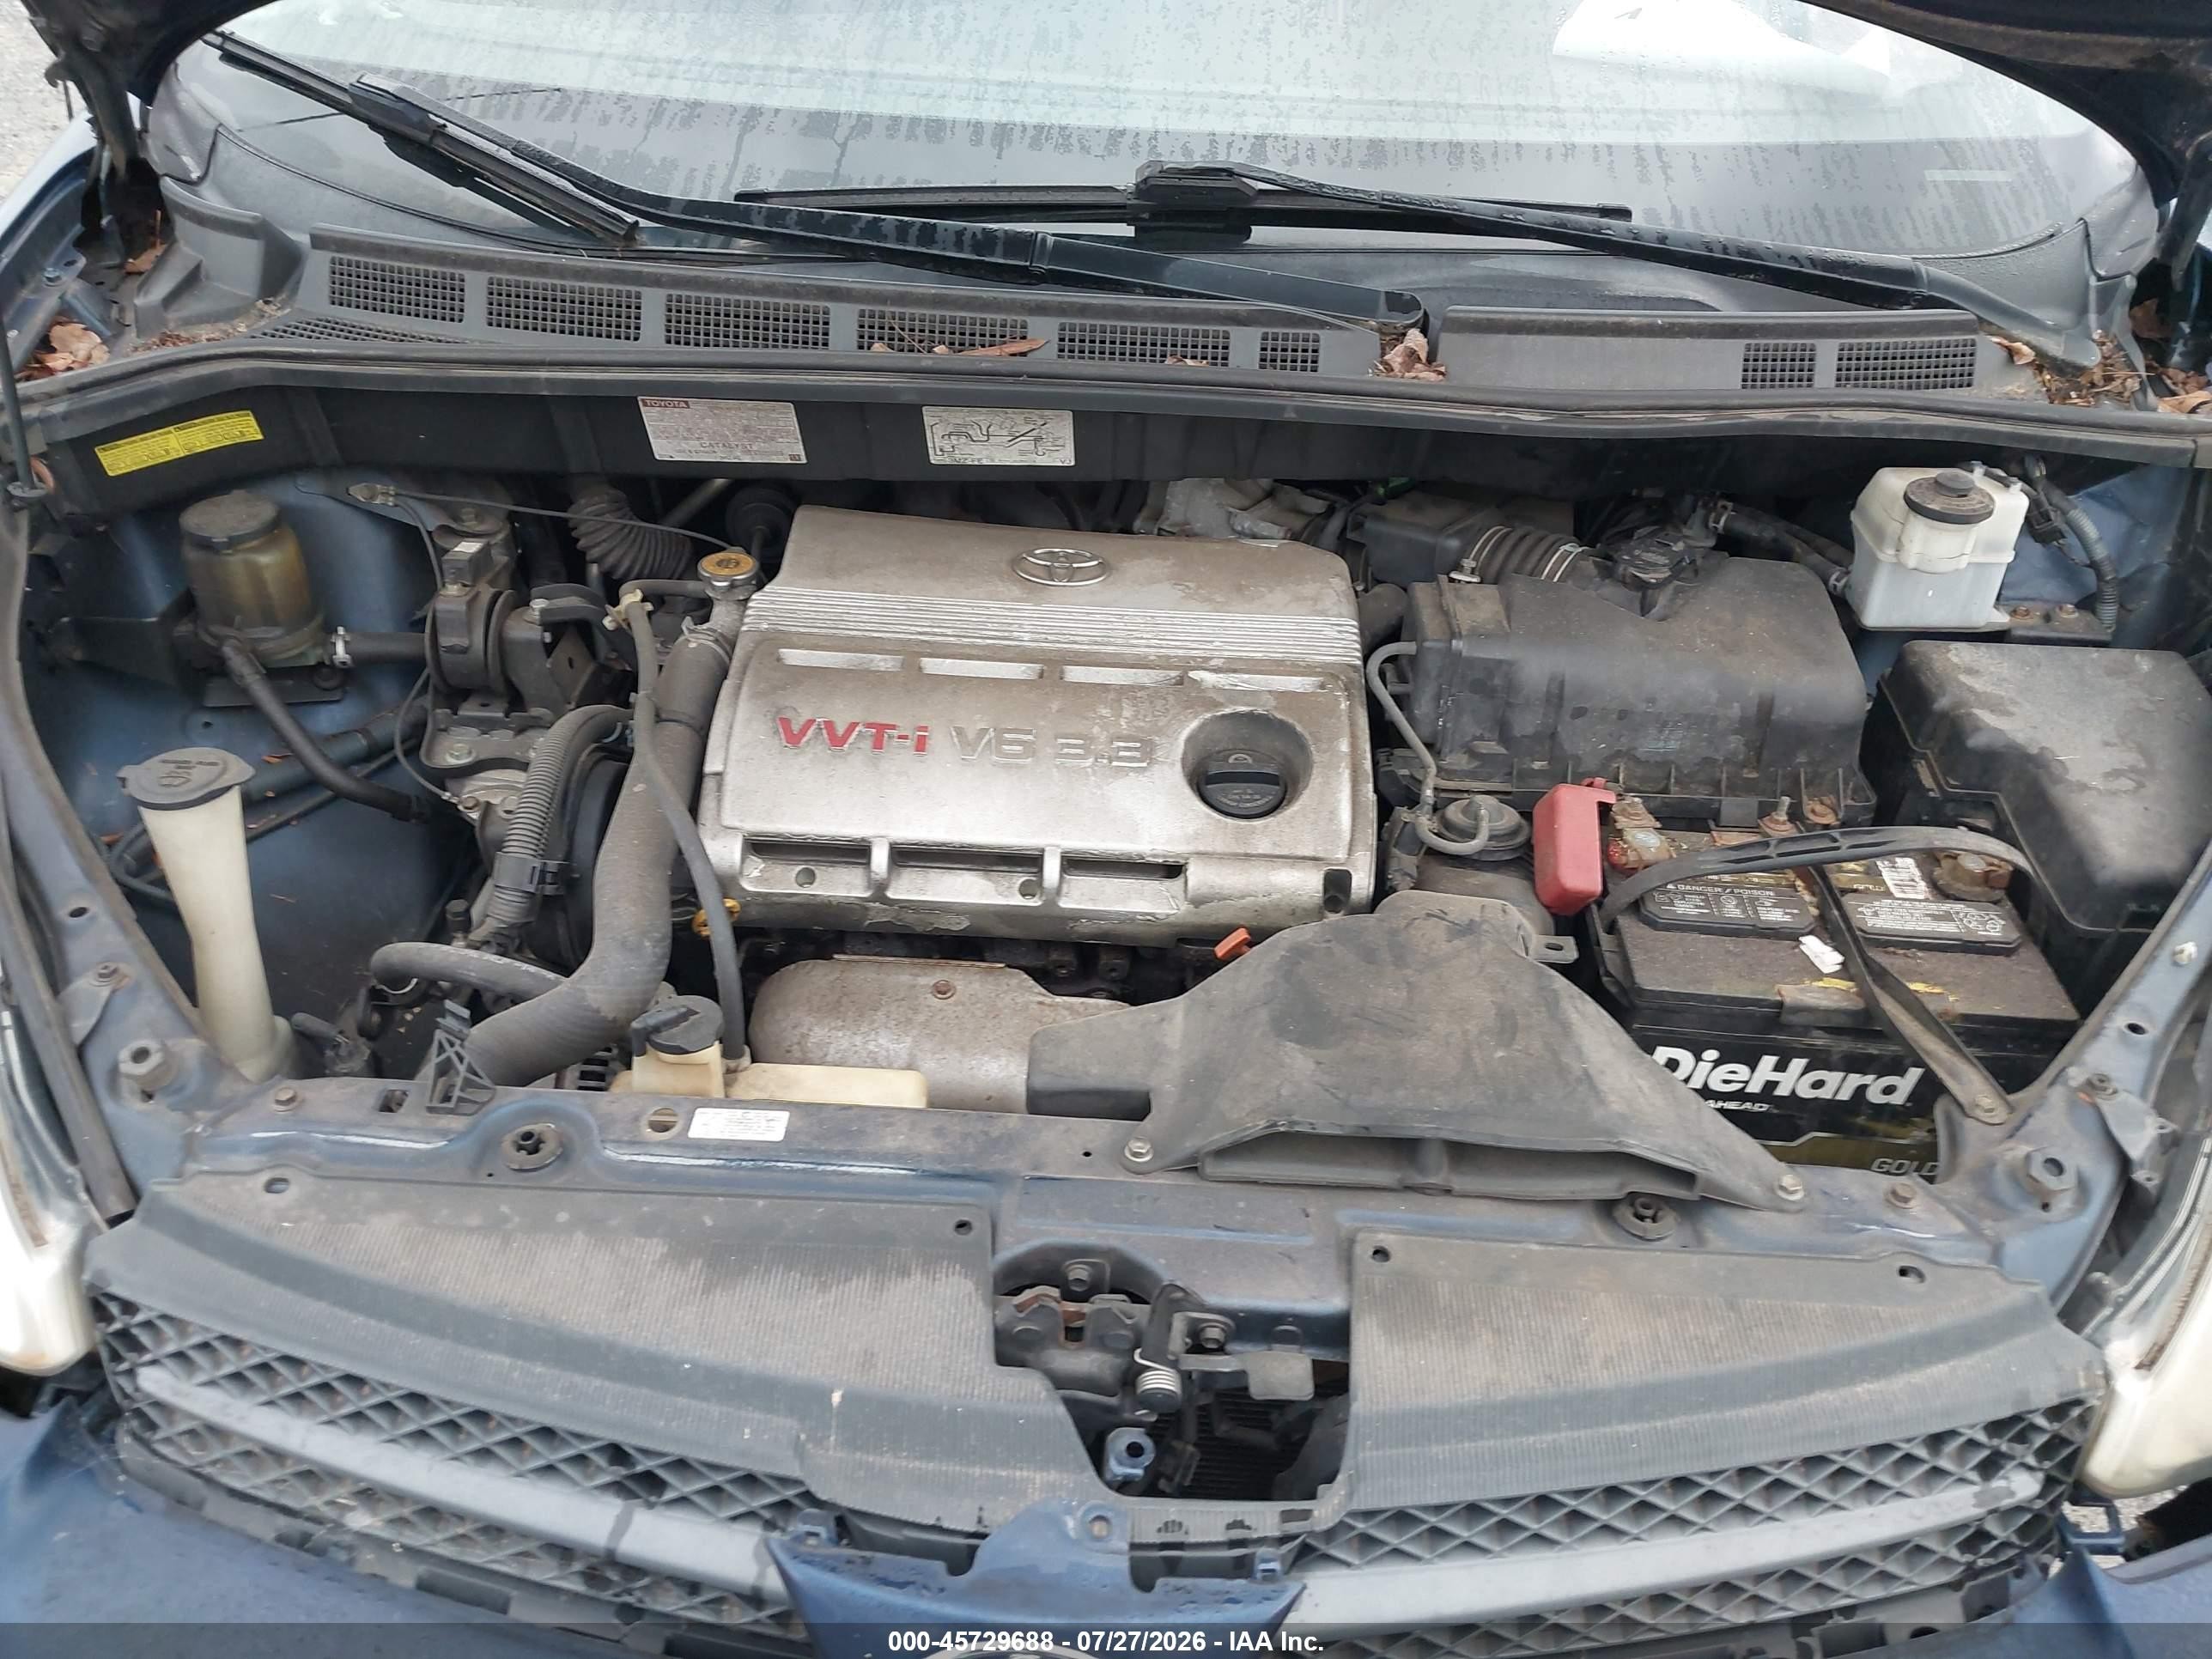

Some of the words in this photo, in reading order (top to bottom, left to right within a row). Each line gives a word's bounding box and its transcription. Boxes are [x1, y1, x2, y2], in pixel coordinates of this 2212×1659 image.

[645, 399, 687, 408] TOYOTA
[700, 441, 754, 449] CATALYST
[777, 716, 930, 757] VVT-i
[950, 726, 1036, 763] V6
[1054, 735, 1154, 768] 3.3
[1677, 884, 1723, 893] DANGER
[1734, 888, 1774, 896] POISON
[1651, 1045, 1925, 1105] DieHard
[1705, 1099, 1772, 1112] AHEAD
[1870, 1158, 1939, 1176] GOLD
